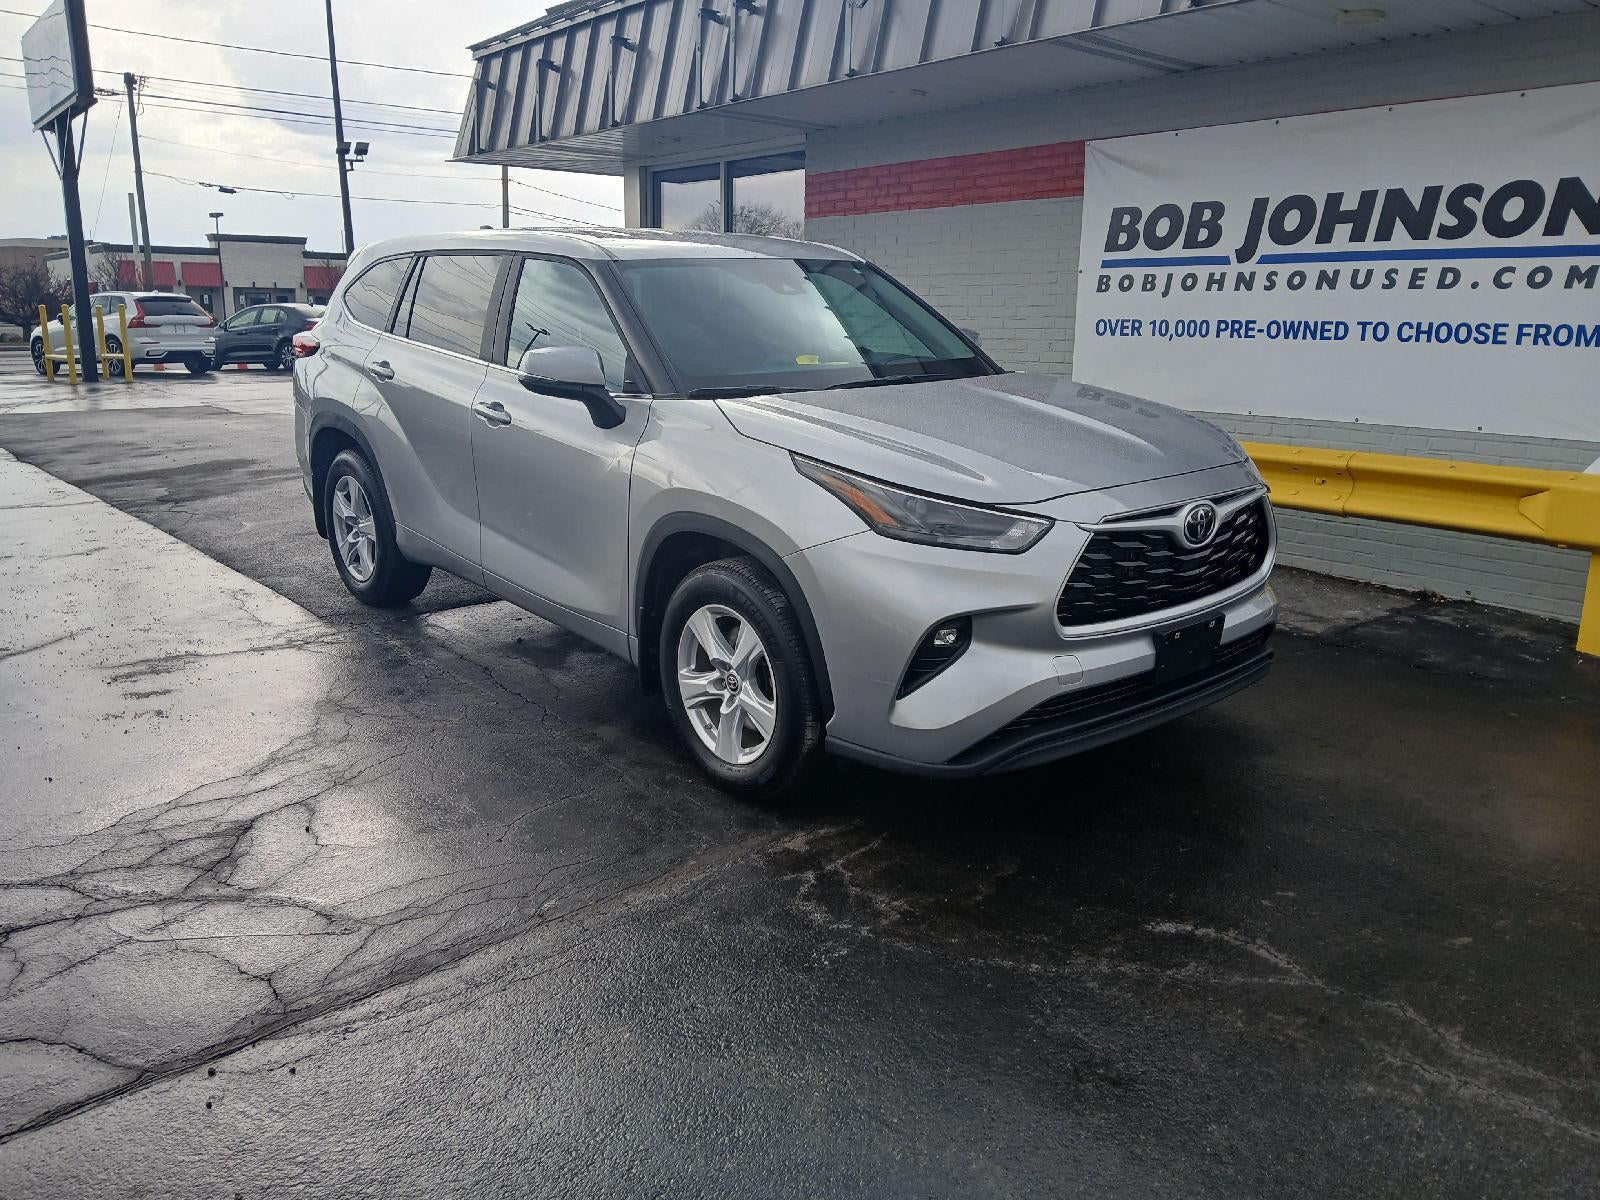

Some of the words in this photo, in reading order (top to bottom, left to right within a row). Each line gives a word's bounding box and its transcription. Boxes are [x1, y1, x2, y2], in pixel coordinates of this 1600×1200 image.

[1104, 200, 1225, 252] BOB
[1235, 176, 1600, 263] JOHNSON
[1096, 264, 1600, 298] BOBJOHNSONUSED.COM
[1095, 319, 1143, 338] OVER
[1148, 319, 1210, 343] 10,000
[1216, 319, 1349, 341] PRE-OWNED
[1357, 320, 1389, 343] TO
[1397, 321, 1509, 346] CHOOSE
[1515, 323, 1600, 347] FROM
